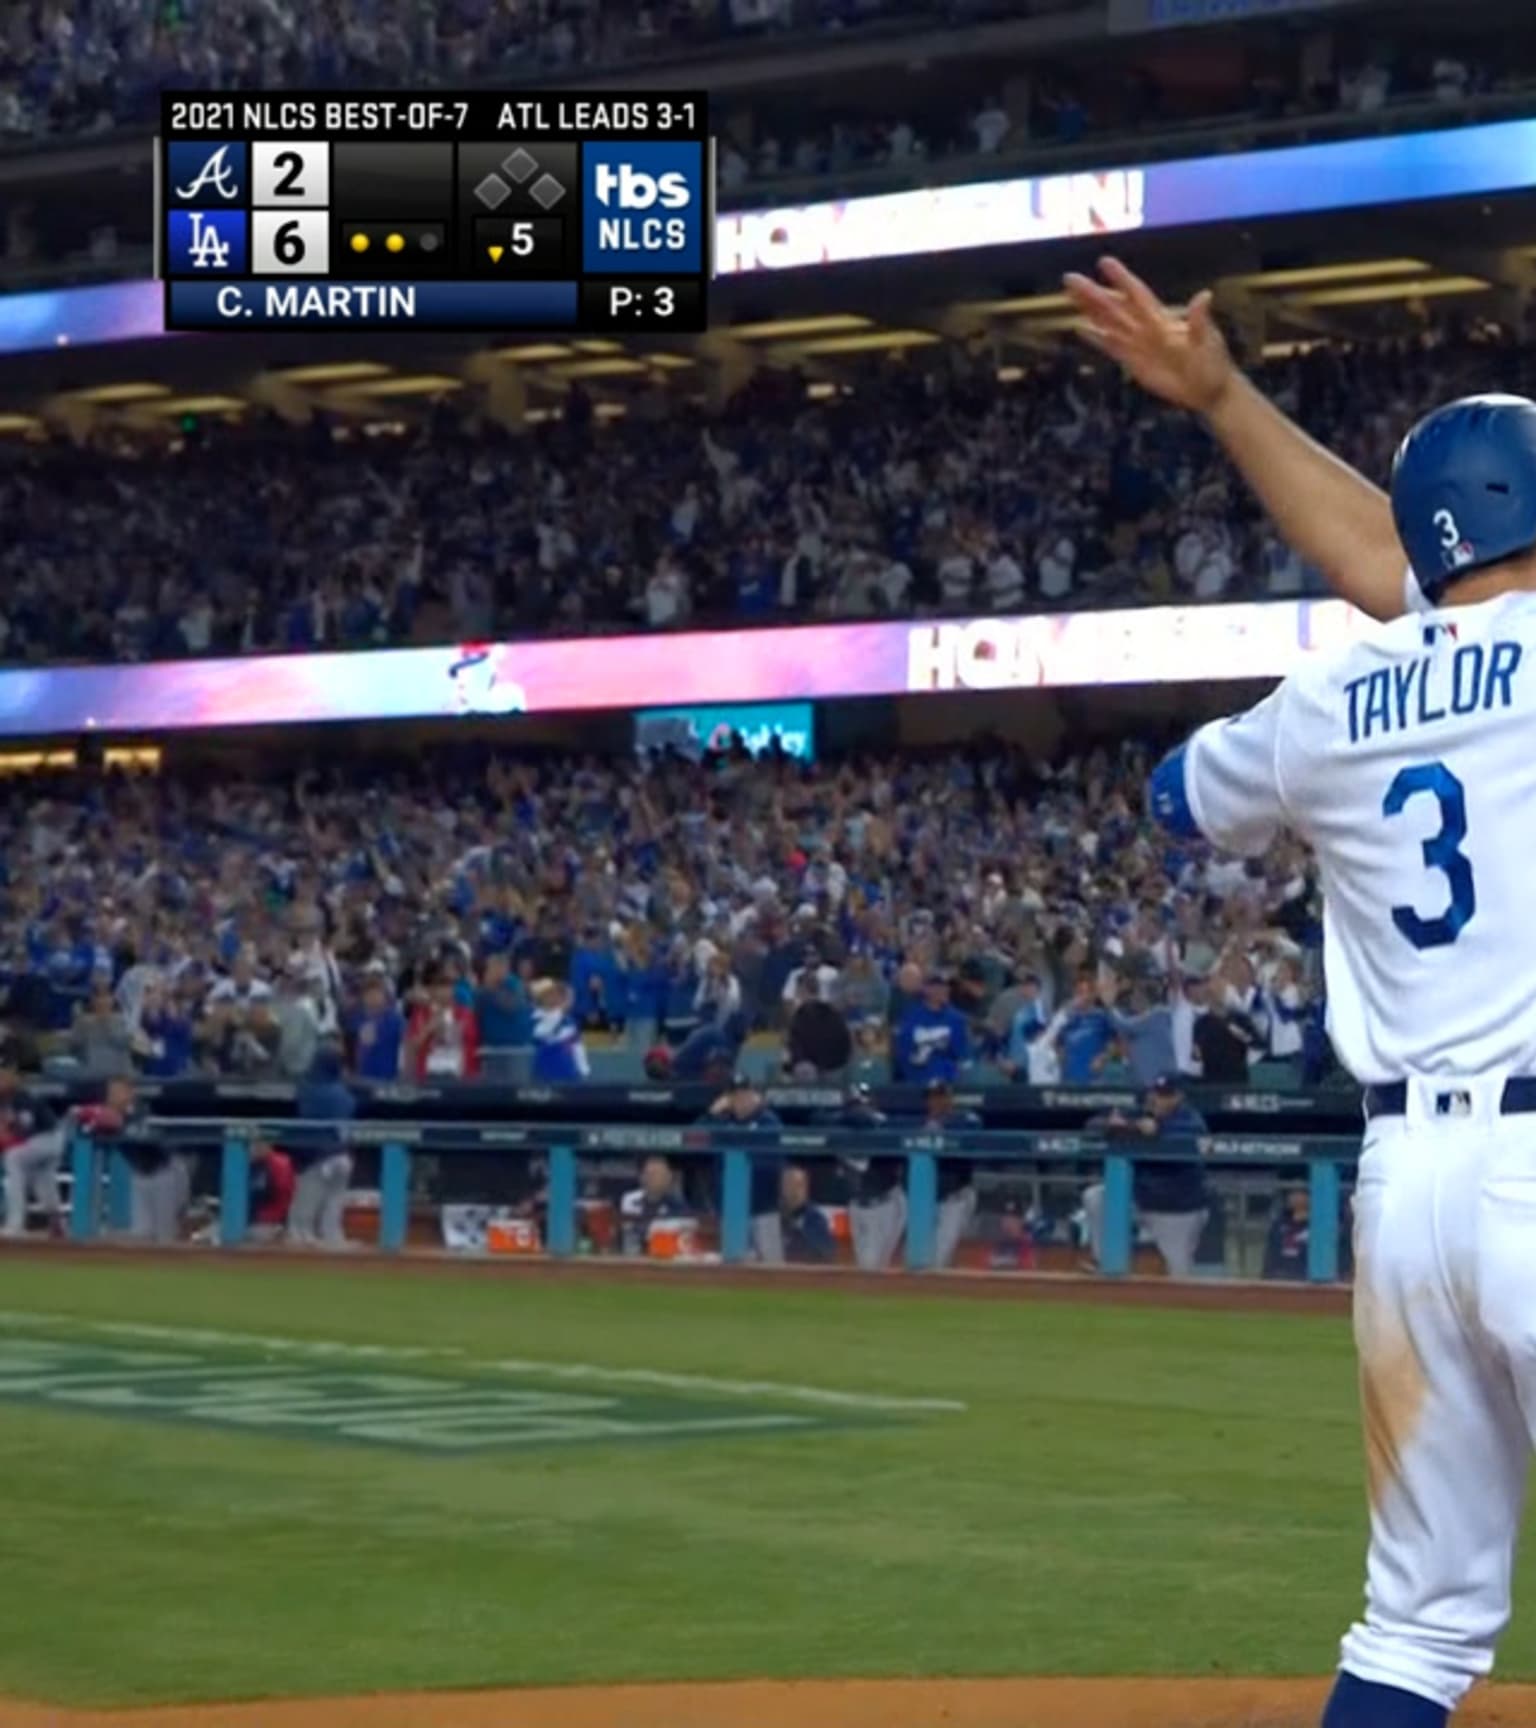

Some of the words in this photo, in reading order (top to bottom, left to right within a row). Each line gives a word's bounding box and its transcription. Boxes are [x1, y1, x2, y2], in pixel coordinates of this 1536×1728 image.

[1433, 508, 1459, 548] 3
[1343, 641, 1523, 743] TAYLOR
[1382, 760, 1476, 951] 3
